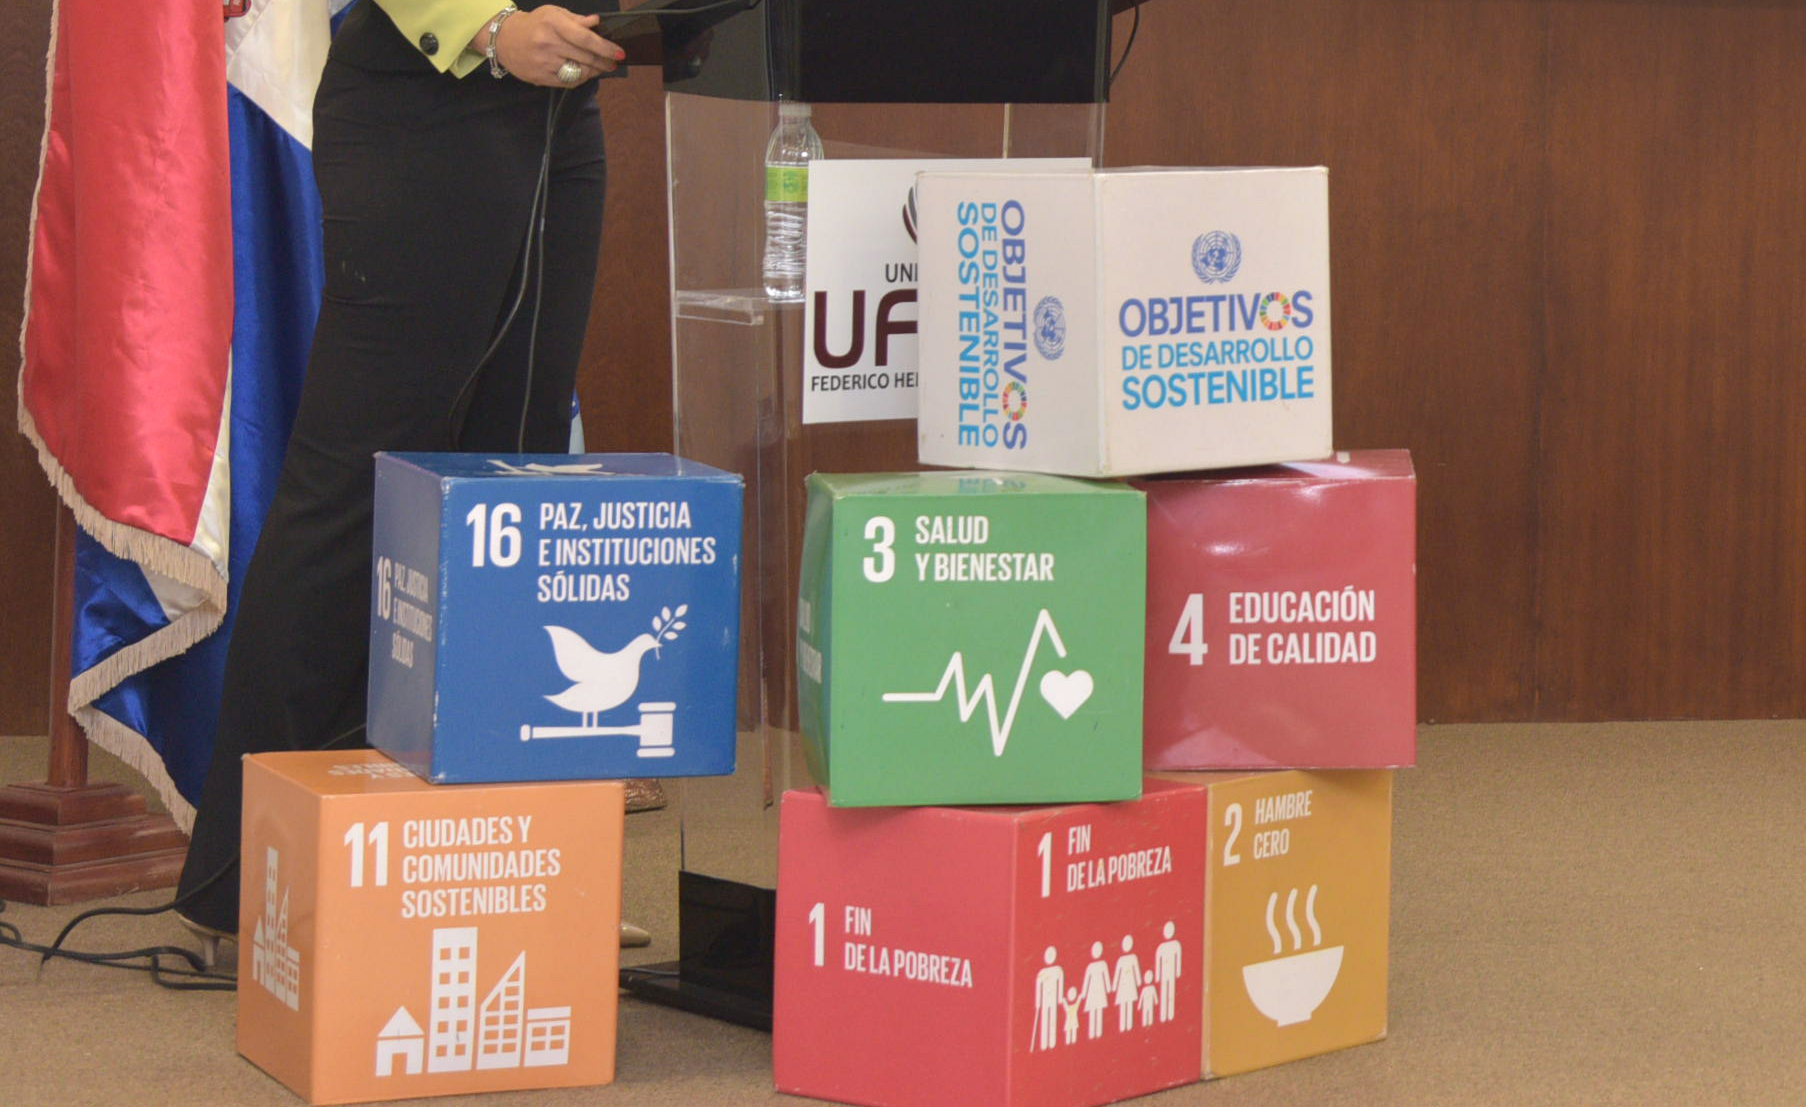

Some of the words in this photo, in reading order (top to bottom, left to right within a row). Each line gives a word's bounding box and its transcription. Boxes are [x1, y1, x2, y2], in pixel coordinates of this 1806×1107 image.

[957, 202, 980, 446] SOSTENIBLE
[1001, 200, 1027, 450] OBJETIVOS
[1118, 290, 1314, 338] OBJETIVOS
[982, 250, 999, 448] DESARROLLO
[1121, 343, 1152, 371] DE
[1157, 335, 1314, 368] DESARROLLO
[811, 372, 890, 392] FEDERICO
[1121, 365, 1315, 411] SOSTENIBLE
[466, 502, 522, 568] 16
[540, 502, 588, 531] PAZ,
[593, 501, 692, 530] JUSTICIA
[555, 537, 717, 566] INSTITUCIONES
[863, 516, 896, 583] 3
[915, 515, 989, 544] SALUD
[537, 570, 630, 603] SÓLIDAS
[934, 553, 1055, 582] BIENESTAR
[1168, 593, 1208, 666] 4
[1229, 585, 1376, 624] EDUCACIÓN
[1229, 633, 1262, 665] DE
[1267, 631, 1377, 665] CALIDAD
[1222, 802, 1243, 867] 2
[1255, 789, 1313, 826] HAMBRE
[1253, 830, 1290, 861] CERO
[344, 821, 390, 888] 11
[403, 817, 513, 849] CIUDADES
[402, 848, 561, 883] COMUNIDADES
[1037, 831, 1053, 898] 1
[1067, 824, 1092, 857] FIN
[1107, 845, 1172, 884] POBREZA
[401, 884, 547, 919] SOSTENIBLES
[808, 902, 825, 968] 1
[844, 905, 872, 937] FIN
[896, 949, 973, 988] POBREZA
